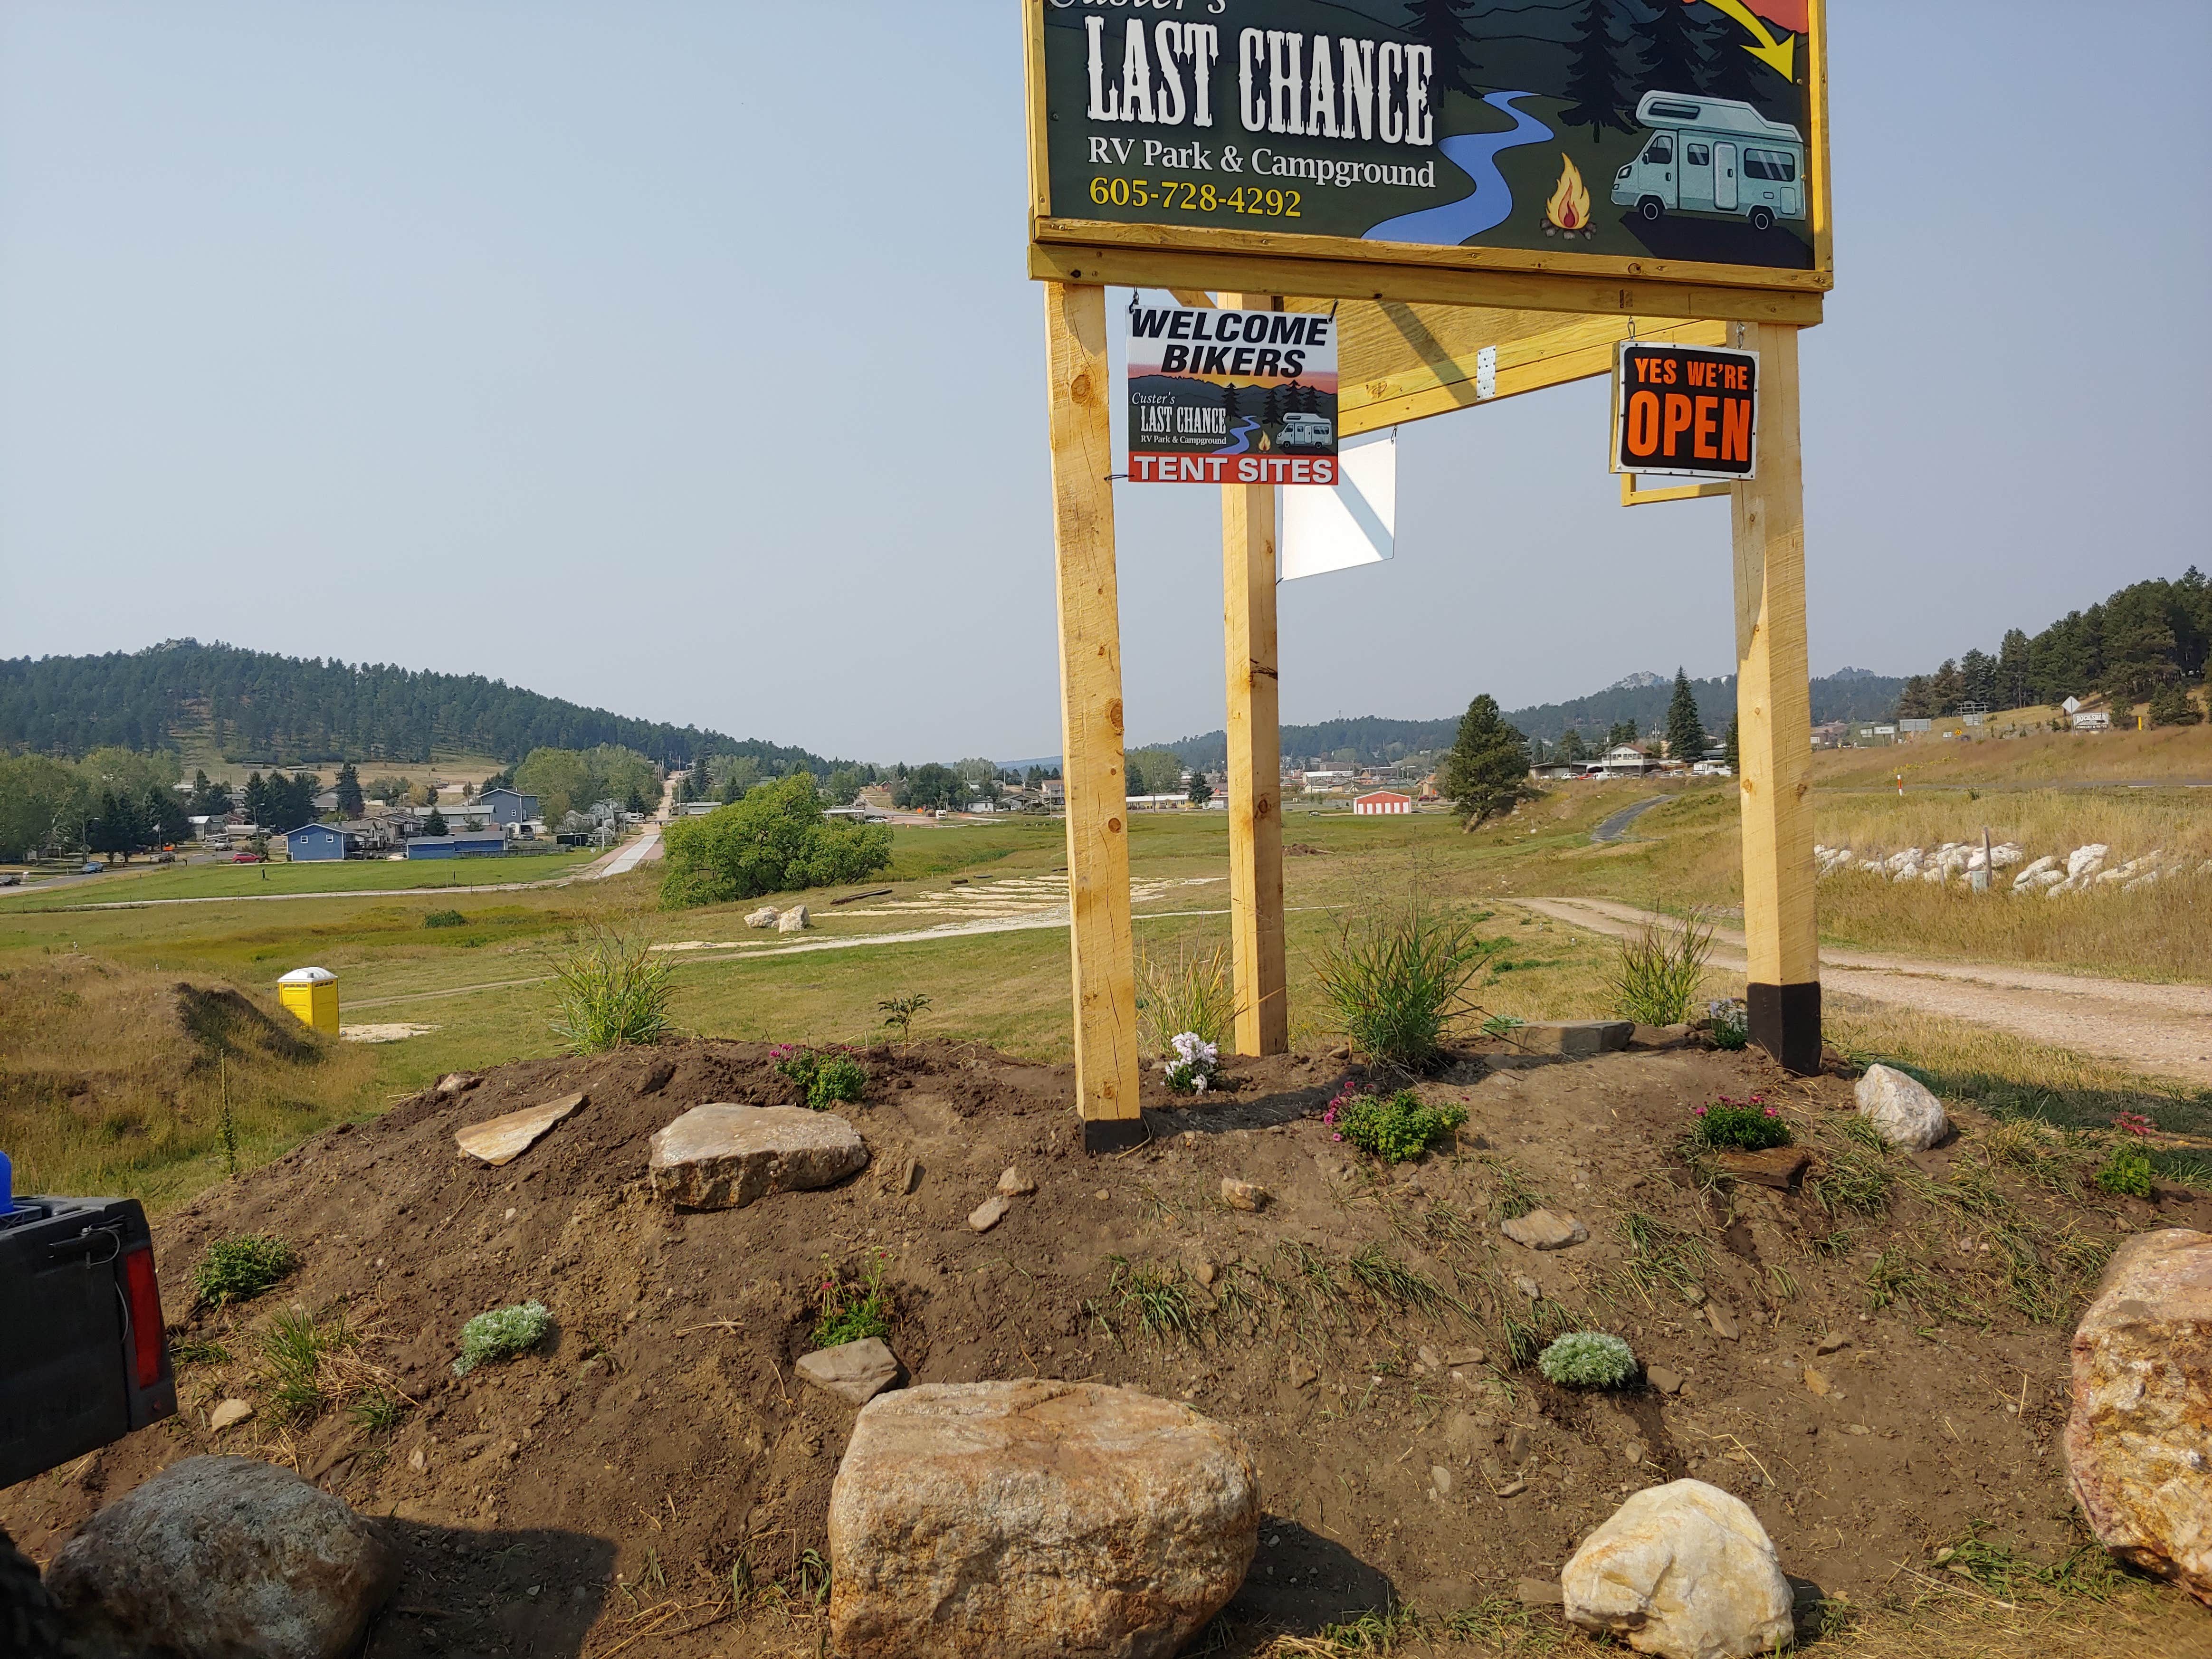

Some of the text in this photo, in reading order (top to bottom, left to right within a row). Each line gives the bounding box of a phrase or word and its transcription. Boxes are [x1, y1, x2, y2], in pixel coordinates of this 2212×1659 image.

[1085, 15, 1433, 147] LAST CHANCE
[1087, 136, 1436, 188] RV Park & Campground
[1090, 177, 1301, 218] 605-728-4292
[1132, 309, 1328, 346] WELCOME
[1161, 344, 1306, 378] BIKERS
[1634, 358, 1748, 391] YES WE'RE
[1132, 391, 1176, 405] Custer's
[1140, 405, 1227, 434] LAST CHANCE
[1627, 391, 1751, 462] OPEN
[1141, 435, 1227, 446] RV Park & Campground
[1134, 456, 1332, 483] TENT SITES
